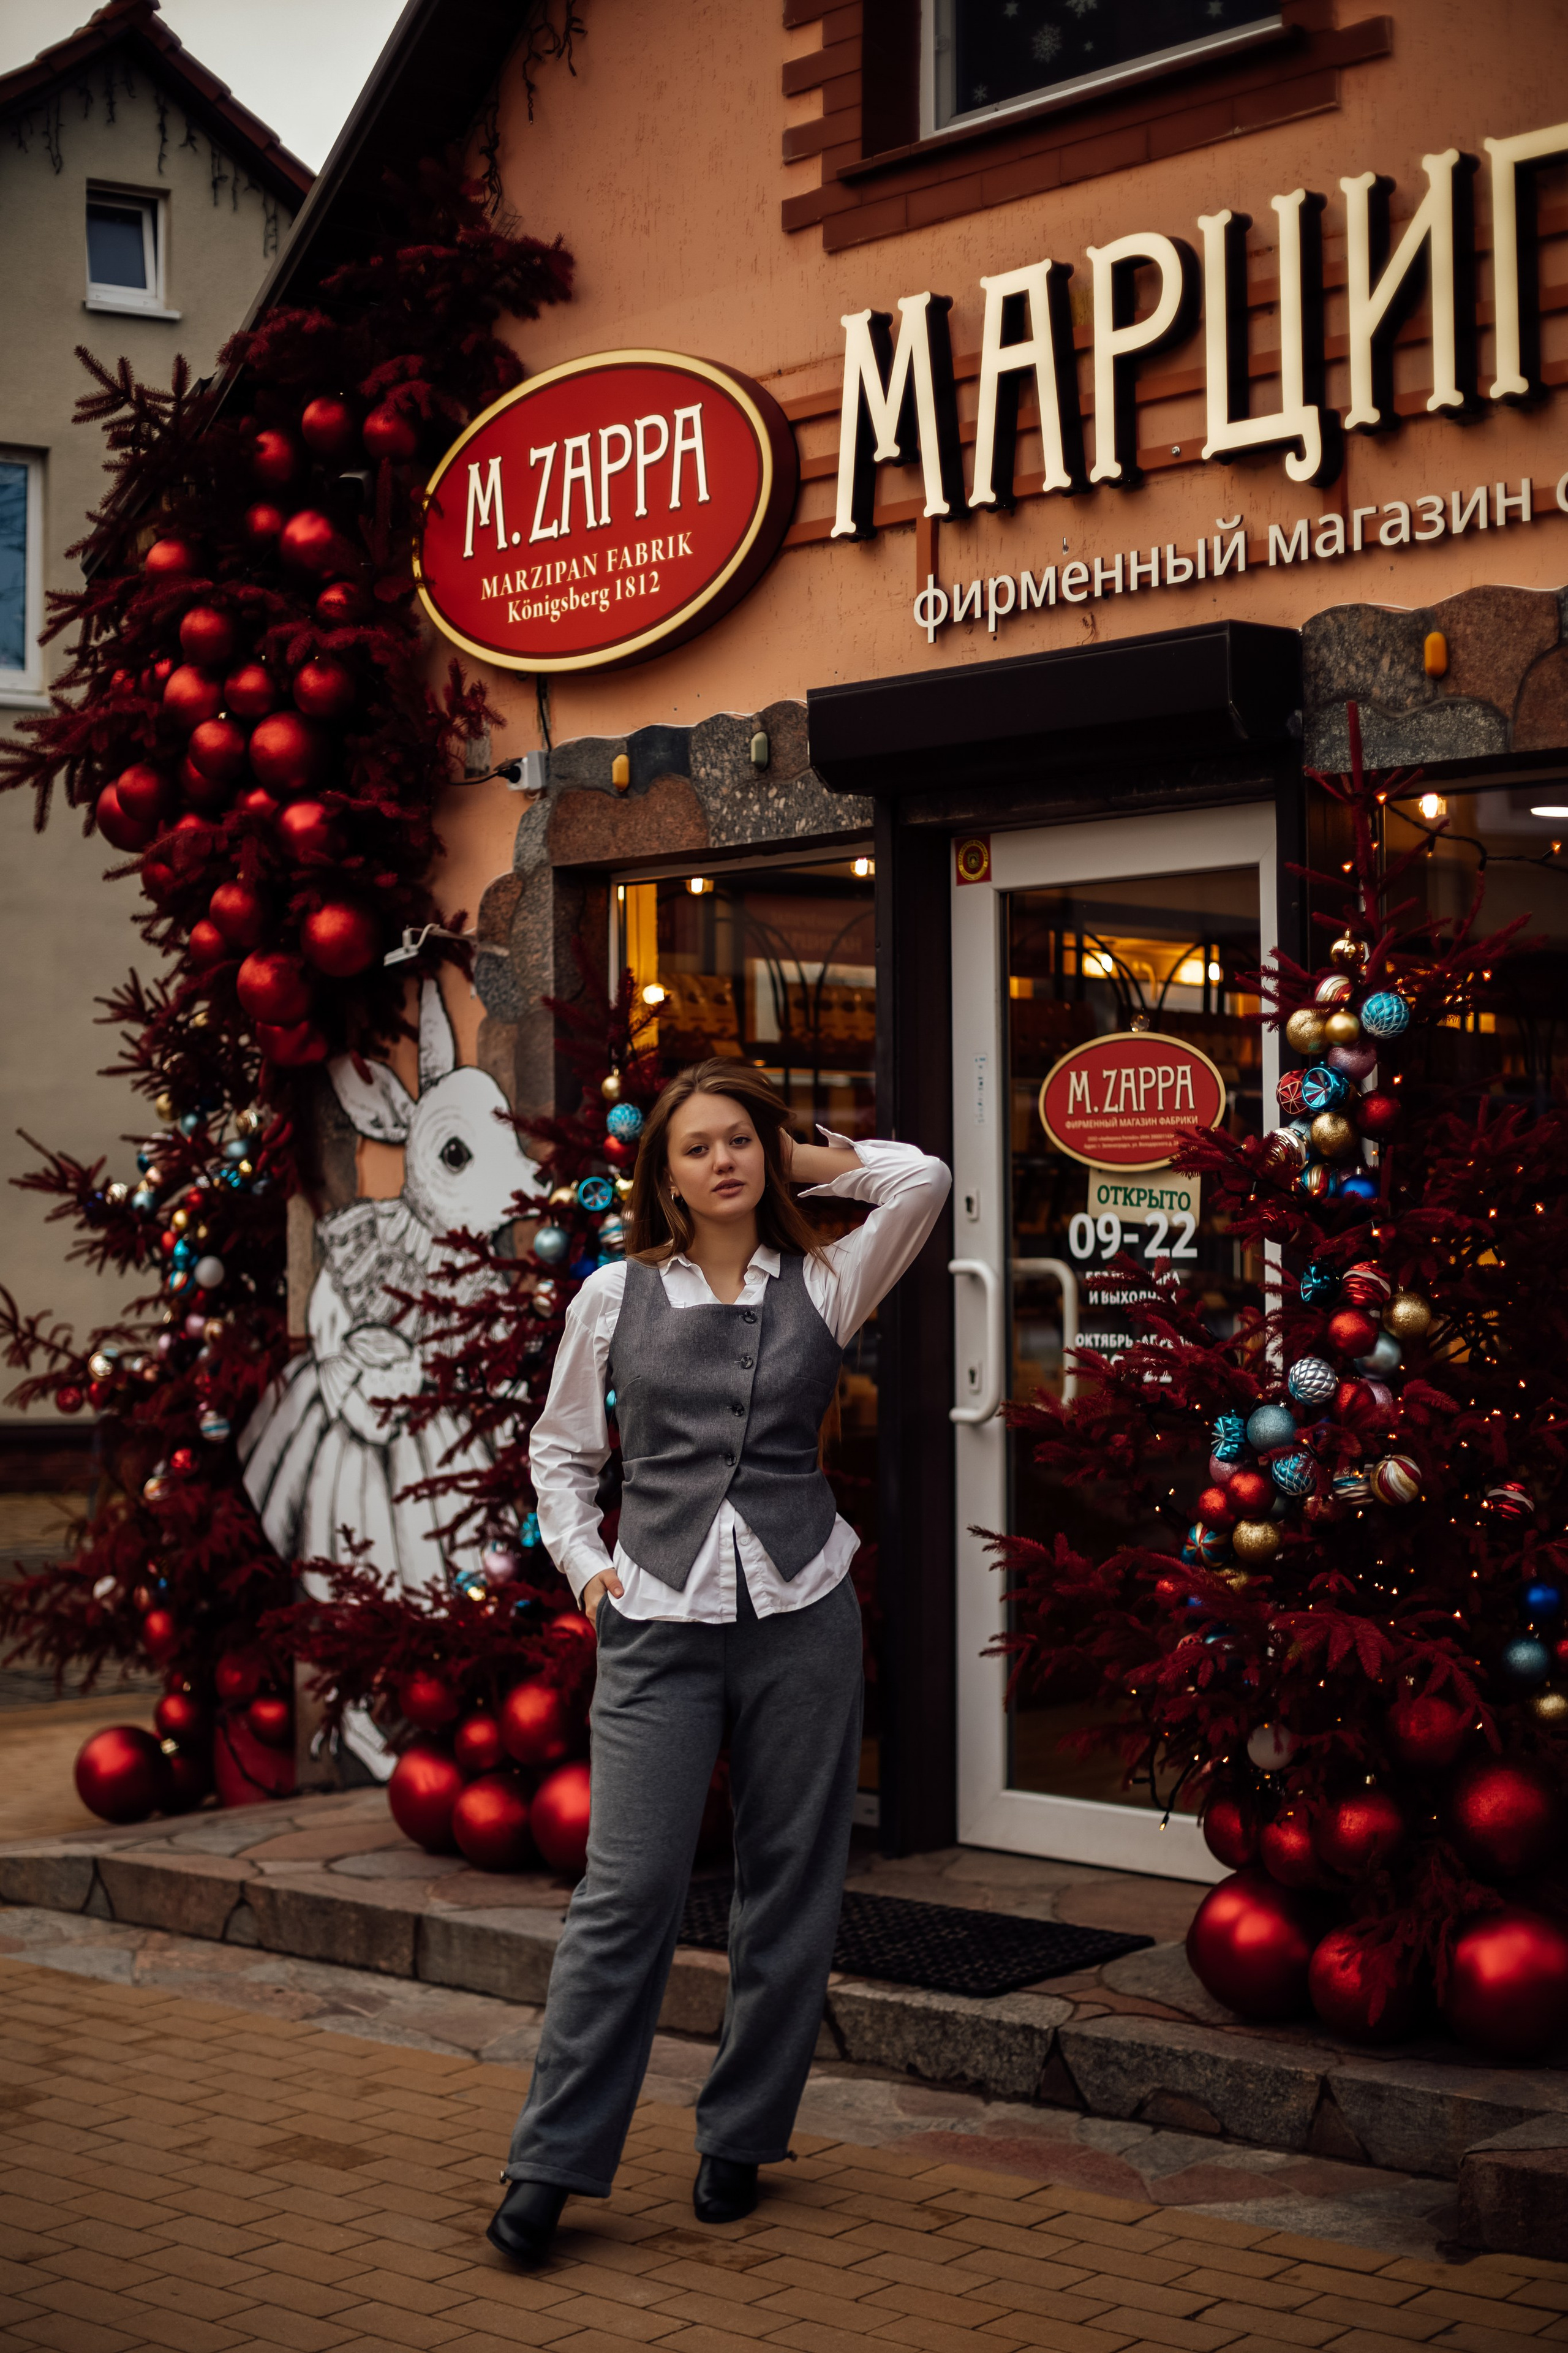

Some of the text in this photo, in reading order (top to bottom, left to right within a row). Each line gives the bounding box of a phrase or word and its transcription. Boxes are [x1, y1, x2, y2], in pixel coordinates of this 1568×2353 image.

[462, 402, 710, 558] M. ZAPPA
[481, 532, 693, 601] MARZIPAN FABRIK
[913, 477, 1531, 643] фирменный магазин
[507, 570, 661, 623] Königsberg 1812
[1068, 1065, 1195, 1114] M. ZAPPA
[1065, 1115, 1198, 1130] ФИРМЕННЫЙ МАГАЗИН ФАБРИКИ
[1097, 1185, 1191, 1211] ОТКРЫТО
[1069, 1211, 1197, 1260] 09-22
[1088, 1290, 1177, 1305] И ВЫХОДН
[1074, 1332, 1134, 1348] ОКТЯБРЬ
